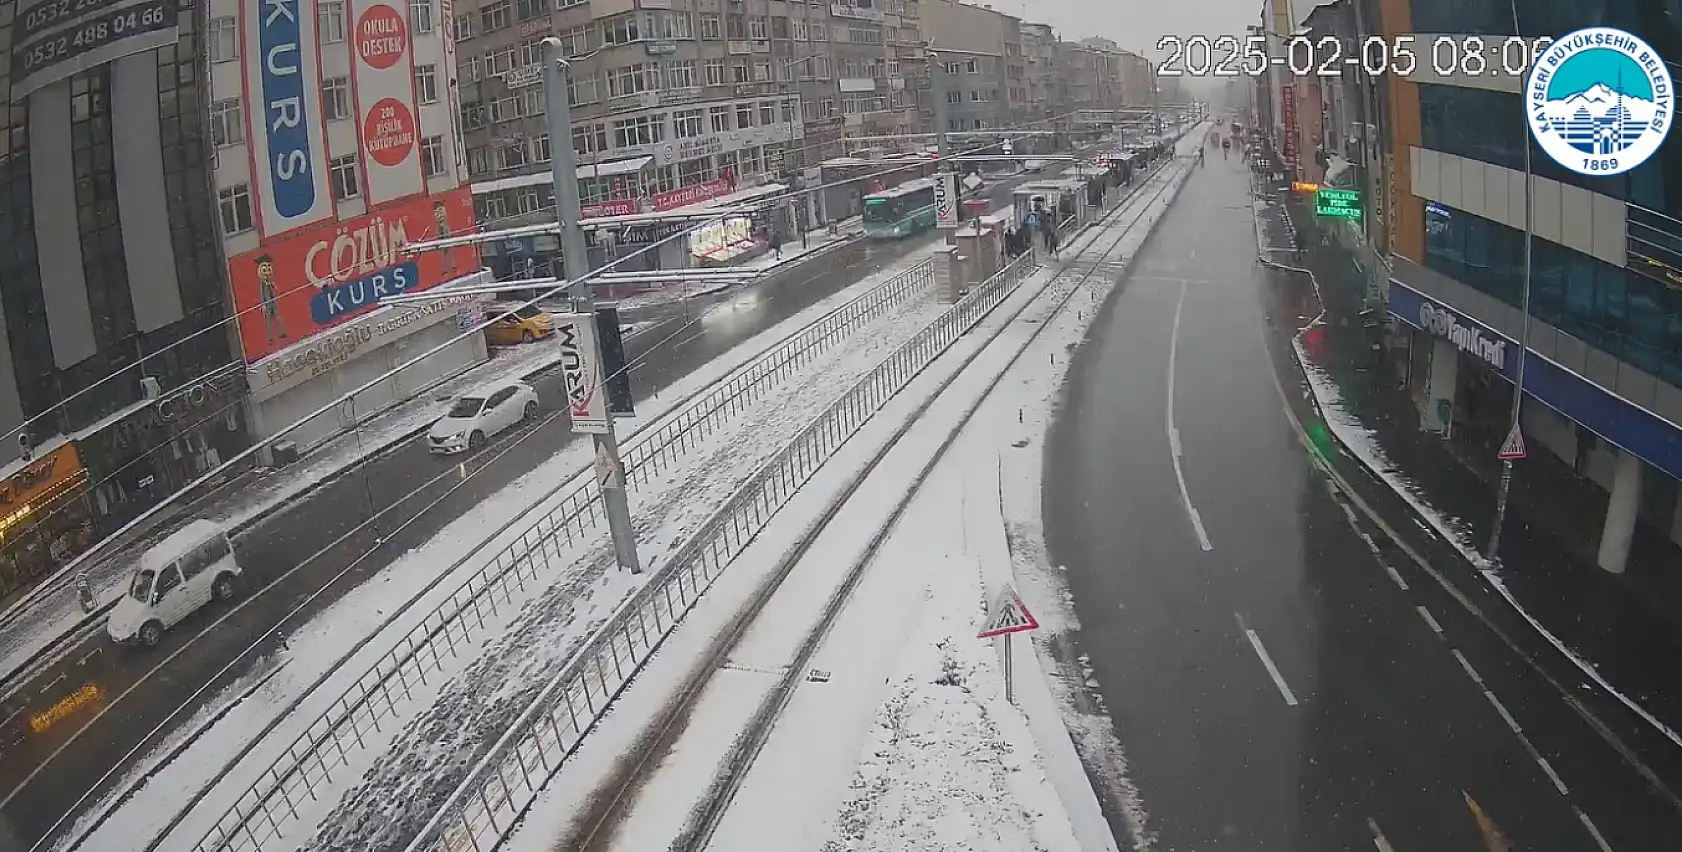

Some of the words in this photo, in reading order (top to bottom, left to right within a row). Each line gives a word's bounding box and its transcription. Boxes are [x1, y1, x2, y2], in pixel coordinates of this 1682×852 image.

[25, 1, 70, 31] 0532
[363, 17, 399, 35] OKULA
[24, 37, 68, 70] 0532
[72, 21, 109, 47] 488
[113, 12, 137, 34] 04
[141, 6, 165, 26] 66
[362, 36, 402, 58] DESTEK
[264, 0, 307, 182] KURS
[379, 106, 396, 120] 200
[326, 267, 407, 315] KURS
[557, 323, 590, 417] KARUM
